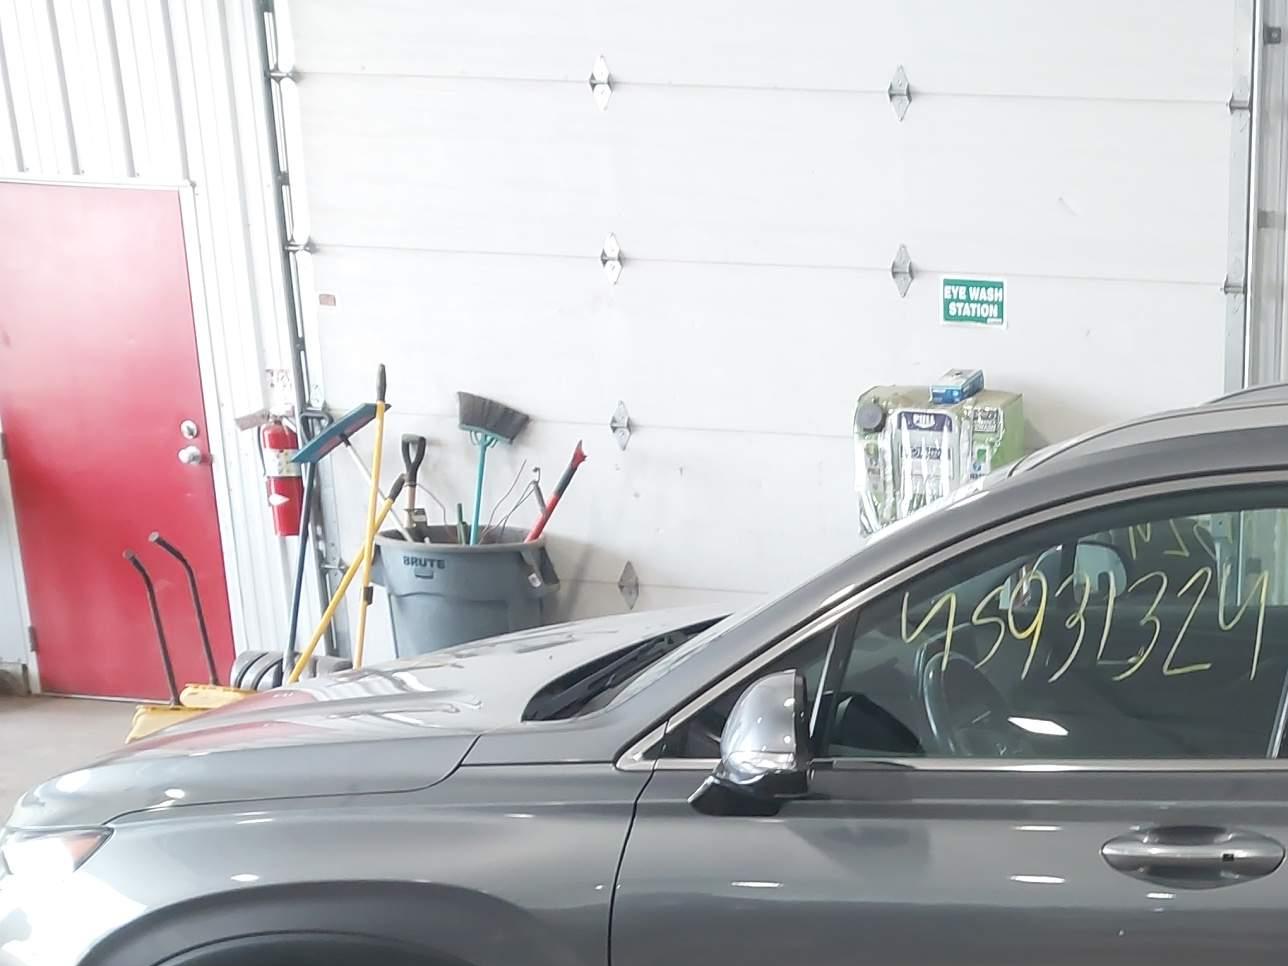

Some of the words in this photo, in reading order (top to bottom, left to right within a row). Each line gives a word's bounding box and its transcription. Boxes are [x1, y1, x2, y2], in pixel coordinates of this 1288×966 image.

[944, 285, 967, 300] EYE
[969, 286, 1003, 302] WASH
[949, 301, 998, 318] STATION
[403, 555, 446, 570] BRUTE
